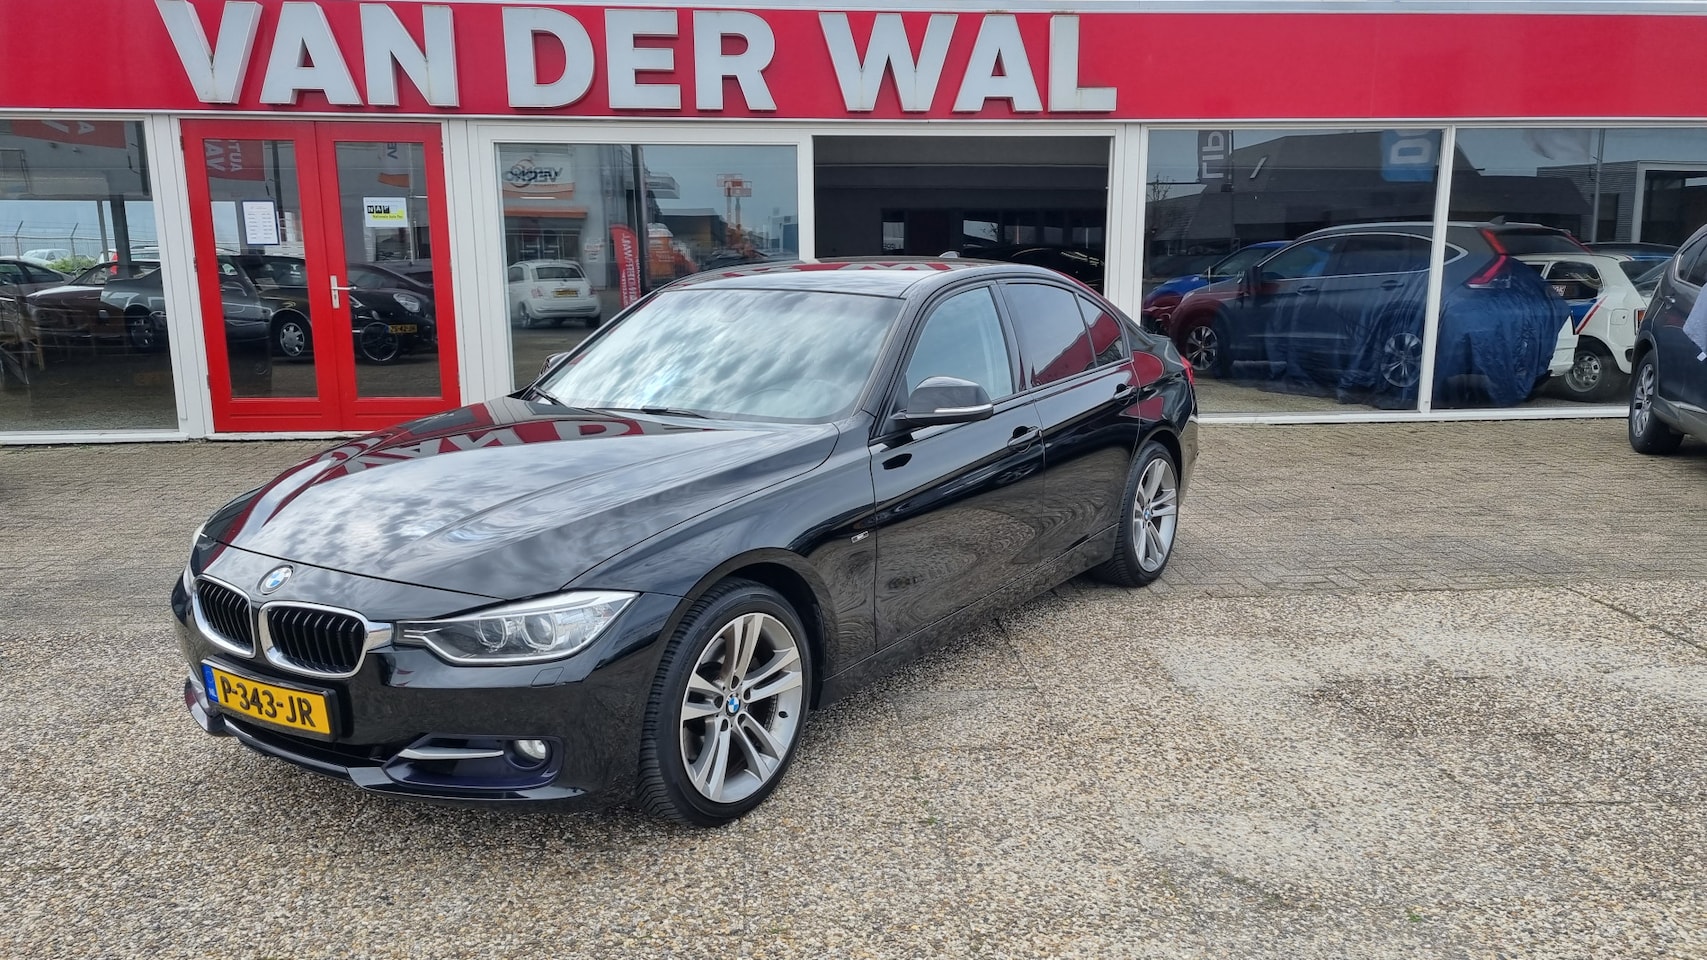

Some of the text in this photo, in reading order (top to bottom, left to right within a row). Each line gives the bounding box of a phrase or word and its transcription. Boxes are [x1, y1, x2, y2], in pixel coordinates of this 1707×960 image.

[155, 0, 1118, 113] VAN DER WAL
[207, 687, 217, 698] NL
[220, 675, 317, 728] P-343-JR
